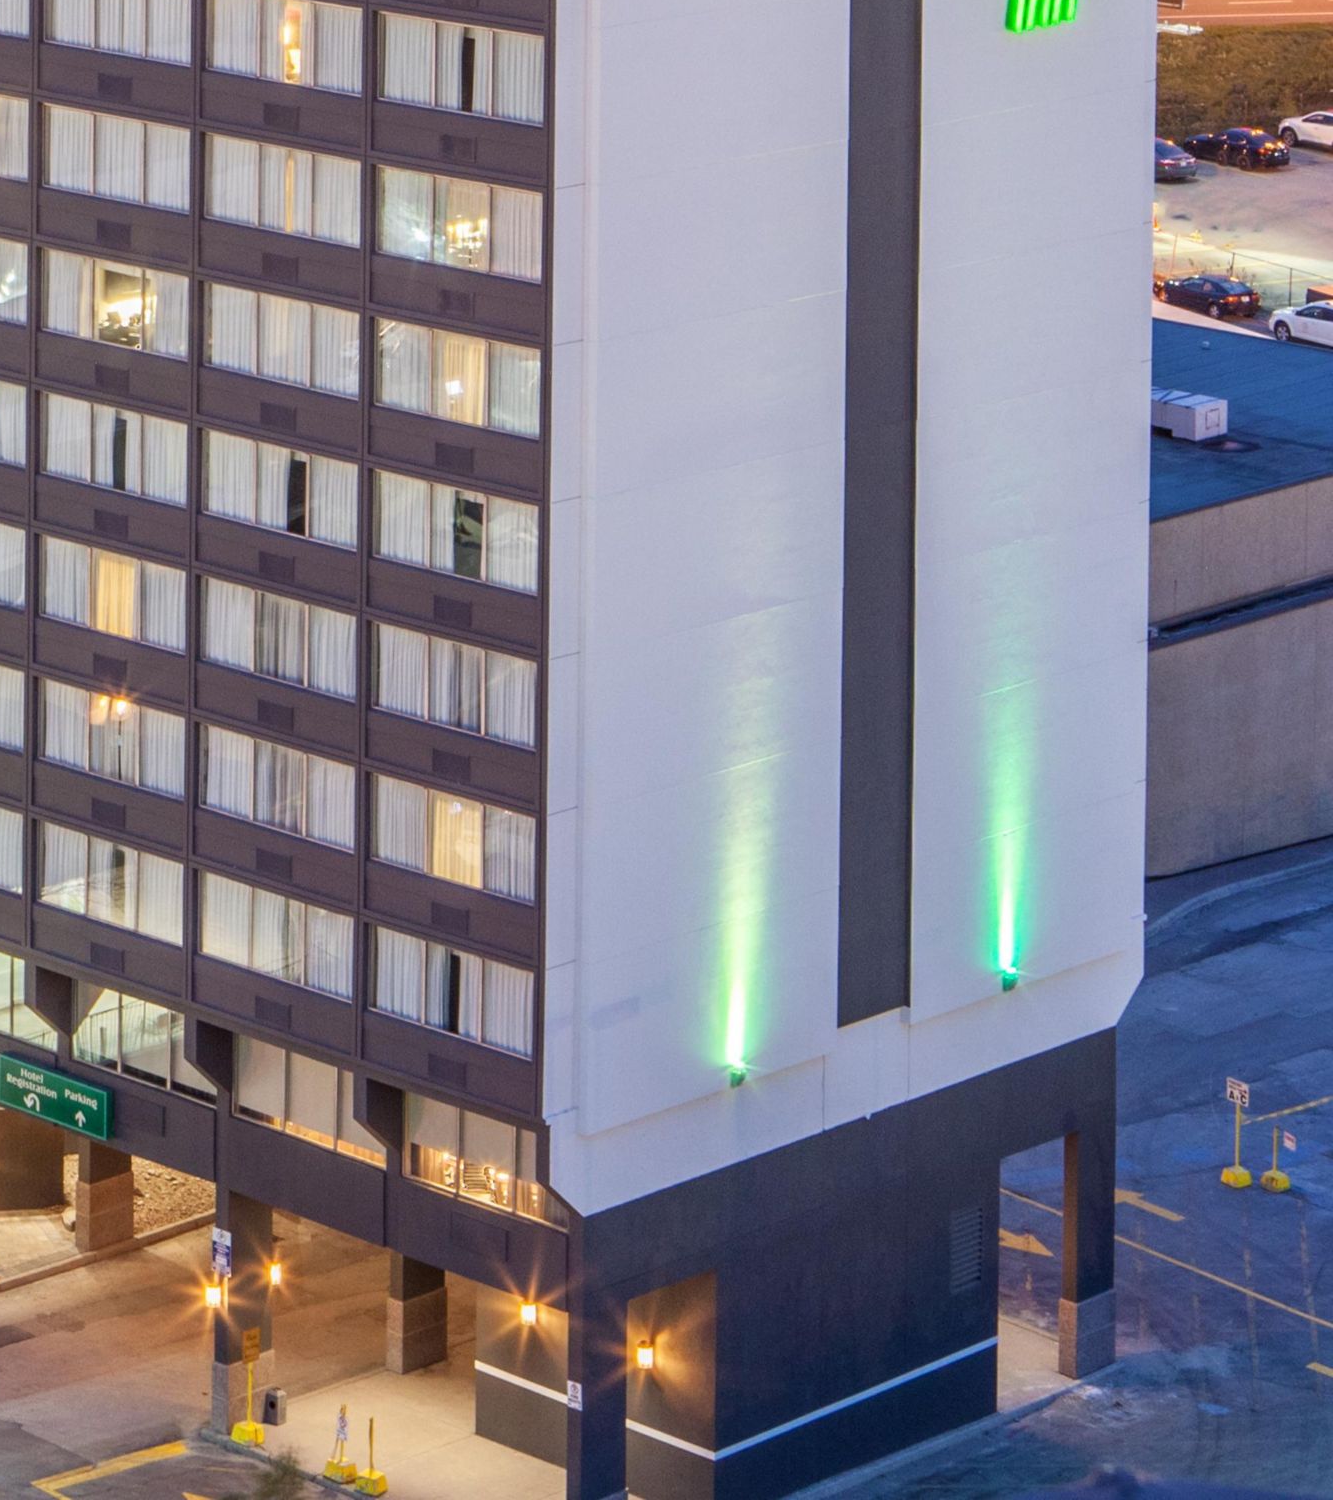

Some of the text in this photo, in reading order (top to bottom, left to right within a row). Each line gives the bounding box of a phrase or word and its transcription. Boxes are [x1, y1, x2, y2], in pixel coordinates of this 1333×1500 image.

[6, 1073, 58, 1100] Registration
[20, 1068, 44, 1084] Hotel
[64, 1088, 98, 1111] Parking
